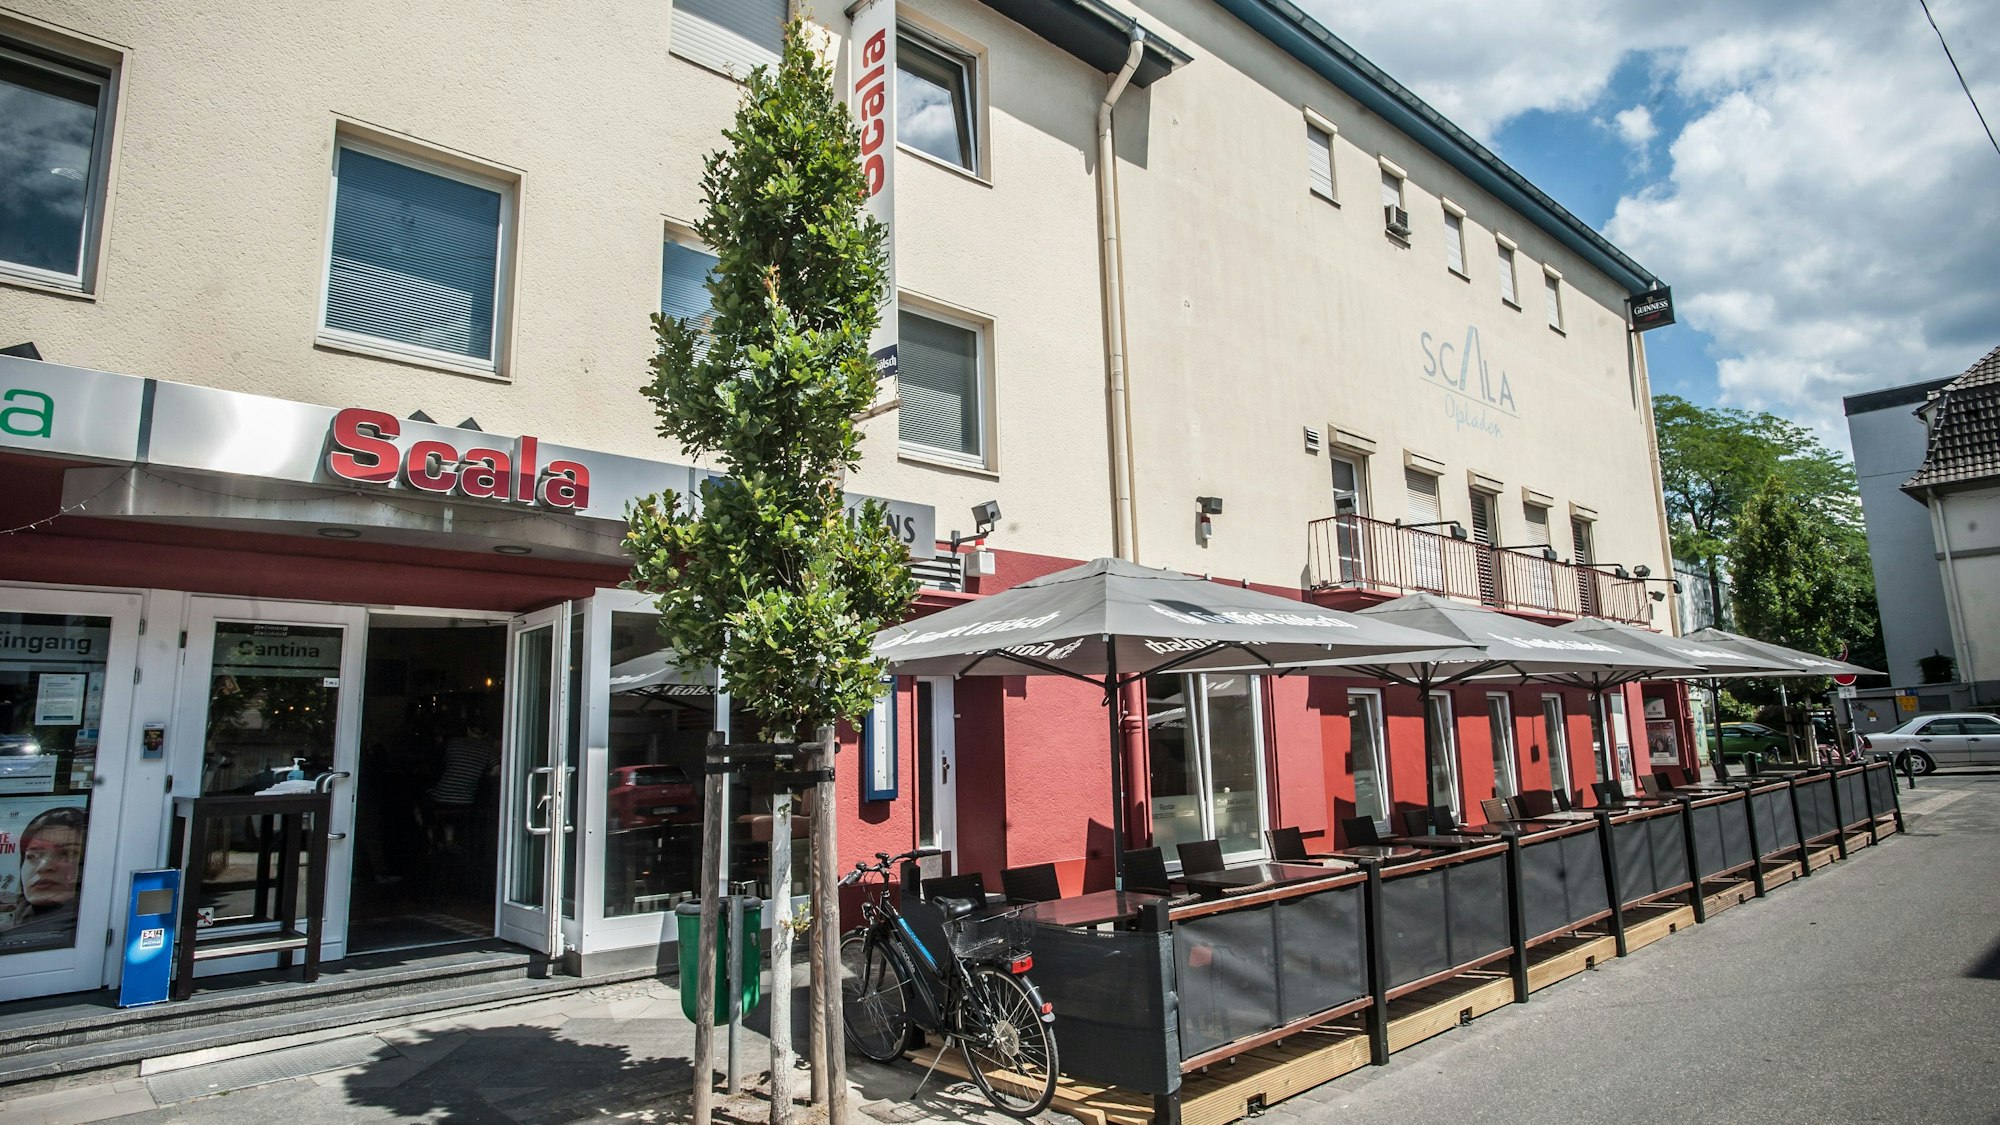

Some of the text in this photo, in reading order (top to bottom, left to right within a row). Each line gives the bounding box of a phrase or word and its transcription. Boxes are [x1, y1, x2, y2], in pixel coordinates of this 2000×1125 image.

[855, 28, 885, 197] Scala
[1633, 300, 1669, 315] GUINNESS
[1420, 325, 1516, 412] SCALA
[1444, 393, 1504, 438] Opladen
[328, 407, 590, 511] Scala
[0, 631, 91, 655] ingang
[239, 640, 320, 658] Cantina
